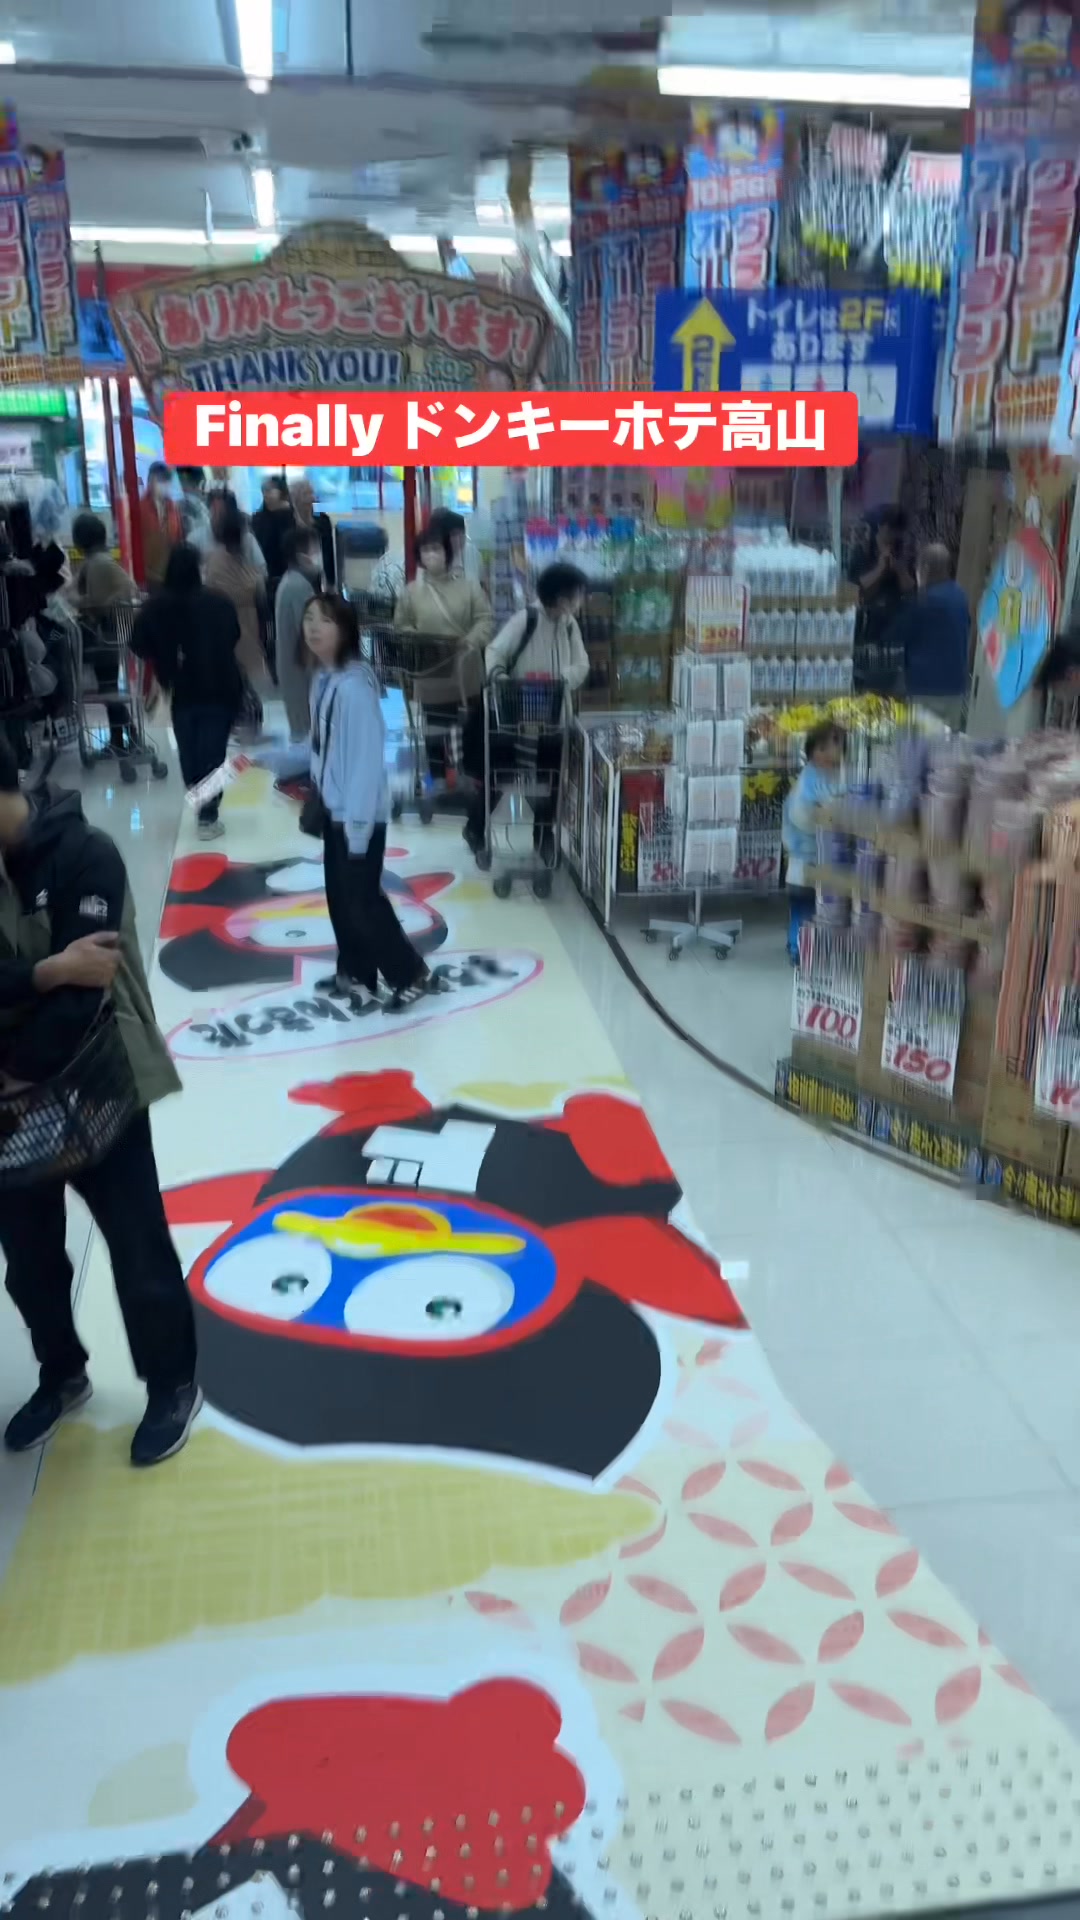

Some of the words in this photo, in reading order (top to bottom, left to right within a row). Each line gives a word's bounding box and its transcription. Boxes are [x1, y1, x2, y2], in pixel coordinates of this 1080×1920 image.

[772, 330, 872, 362] あります
[316, 348, 402, 385] YOU!
[806, 1004, 857, 1039] 100
[893, 1044, 951, 1081] 150
